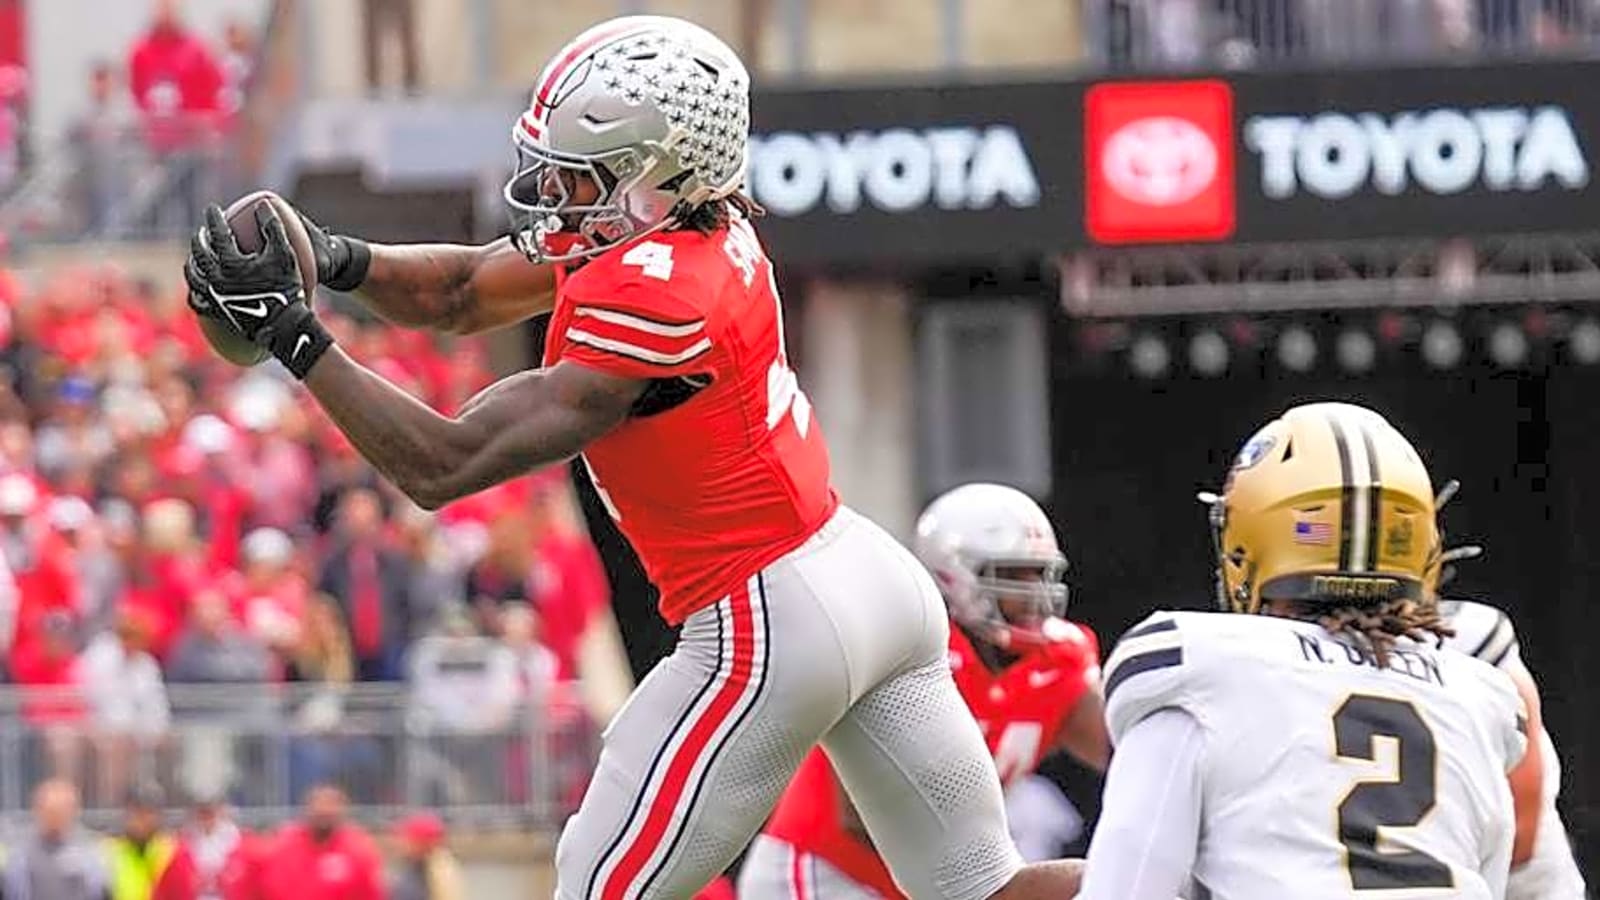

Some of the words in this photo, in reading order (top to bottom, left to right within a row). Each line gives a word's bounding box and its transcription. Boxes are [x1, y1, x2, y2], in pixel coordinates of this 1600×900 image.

[749, 125, 1040, 217] OYOTA
[1245, 104, 1590, 200] TOYOTA
[621, 239, 675, 282] 4
[1292, 630, 1335, 664] N.
[1334, 638, 1445, 687] GEEN
[1331, 691, 1455, 891] 2
